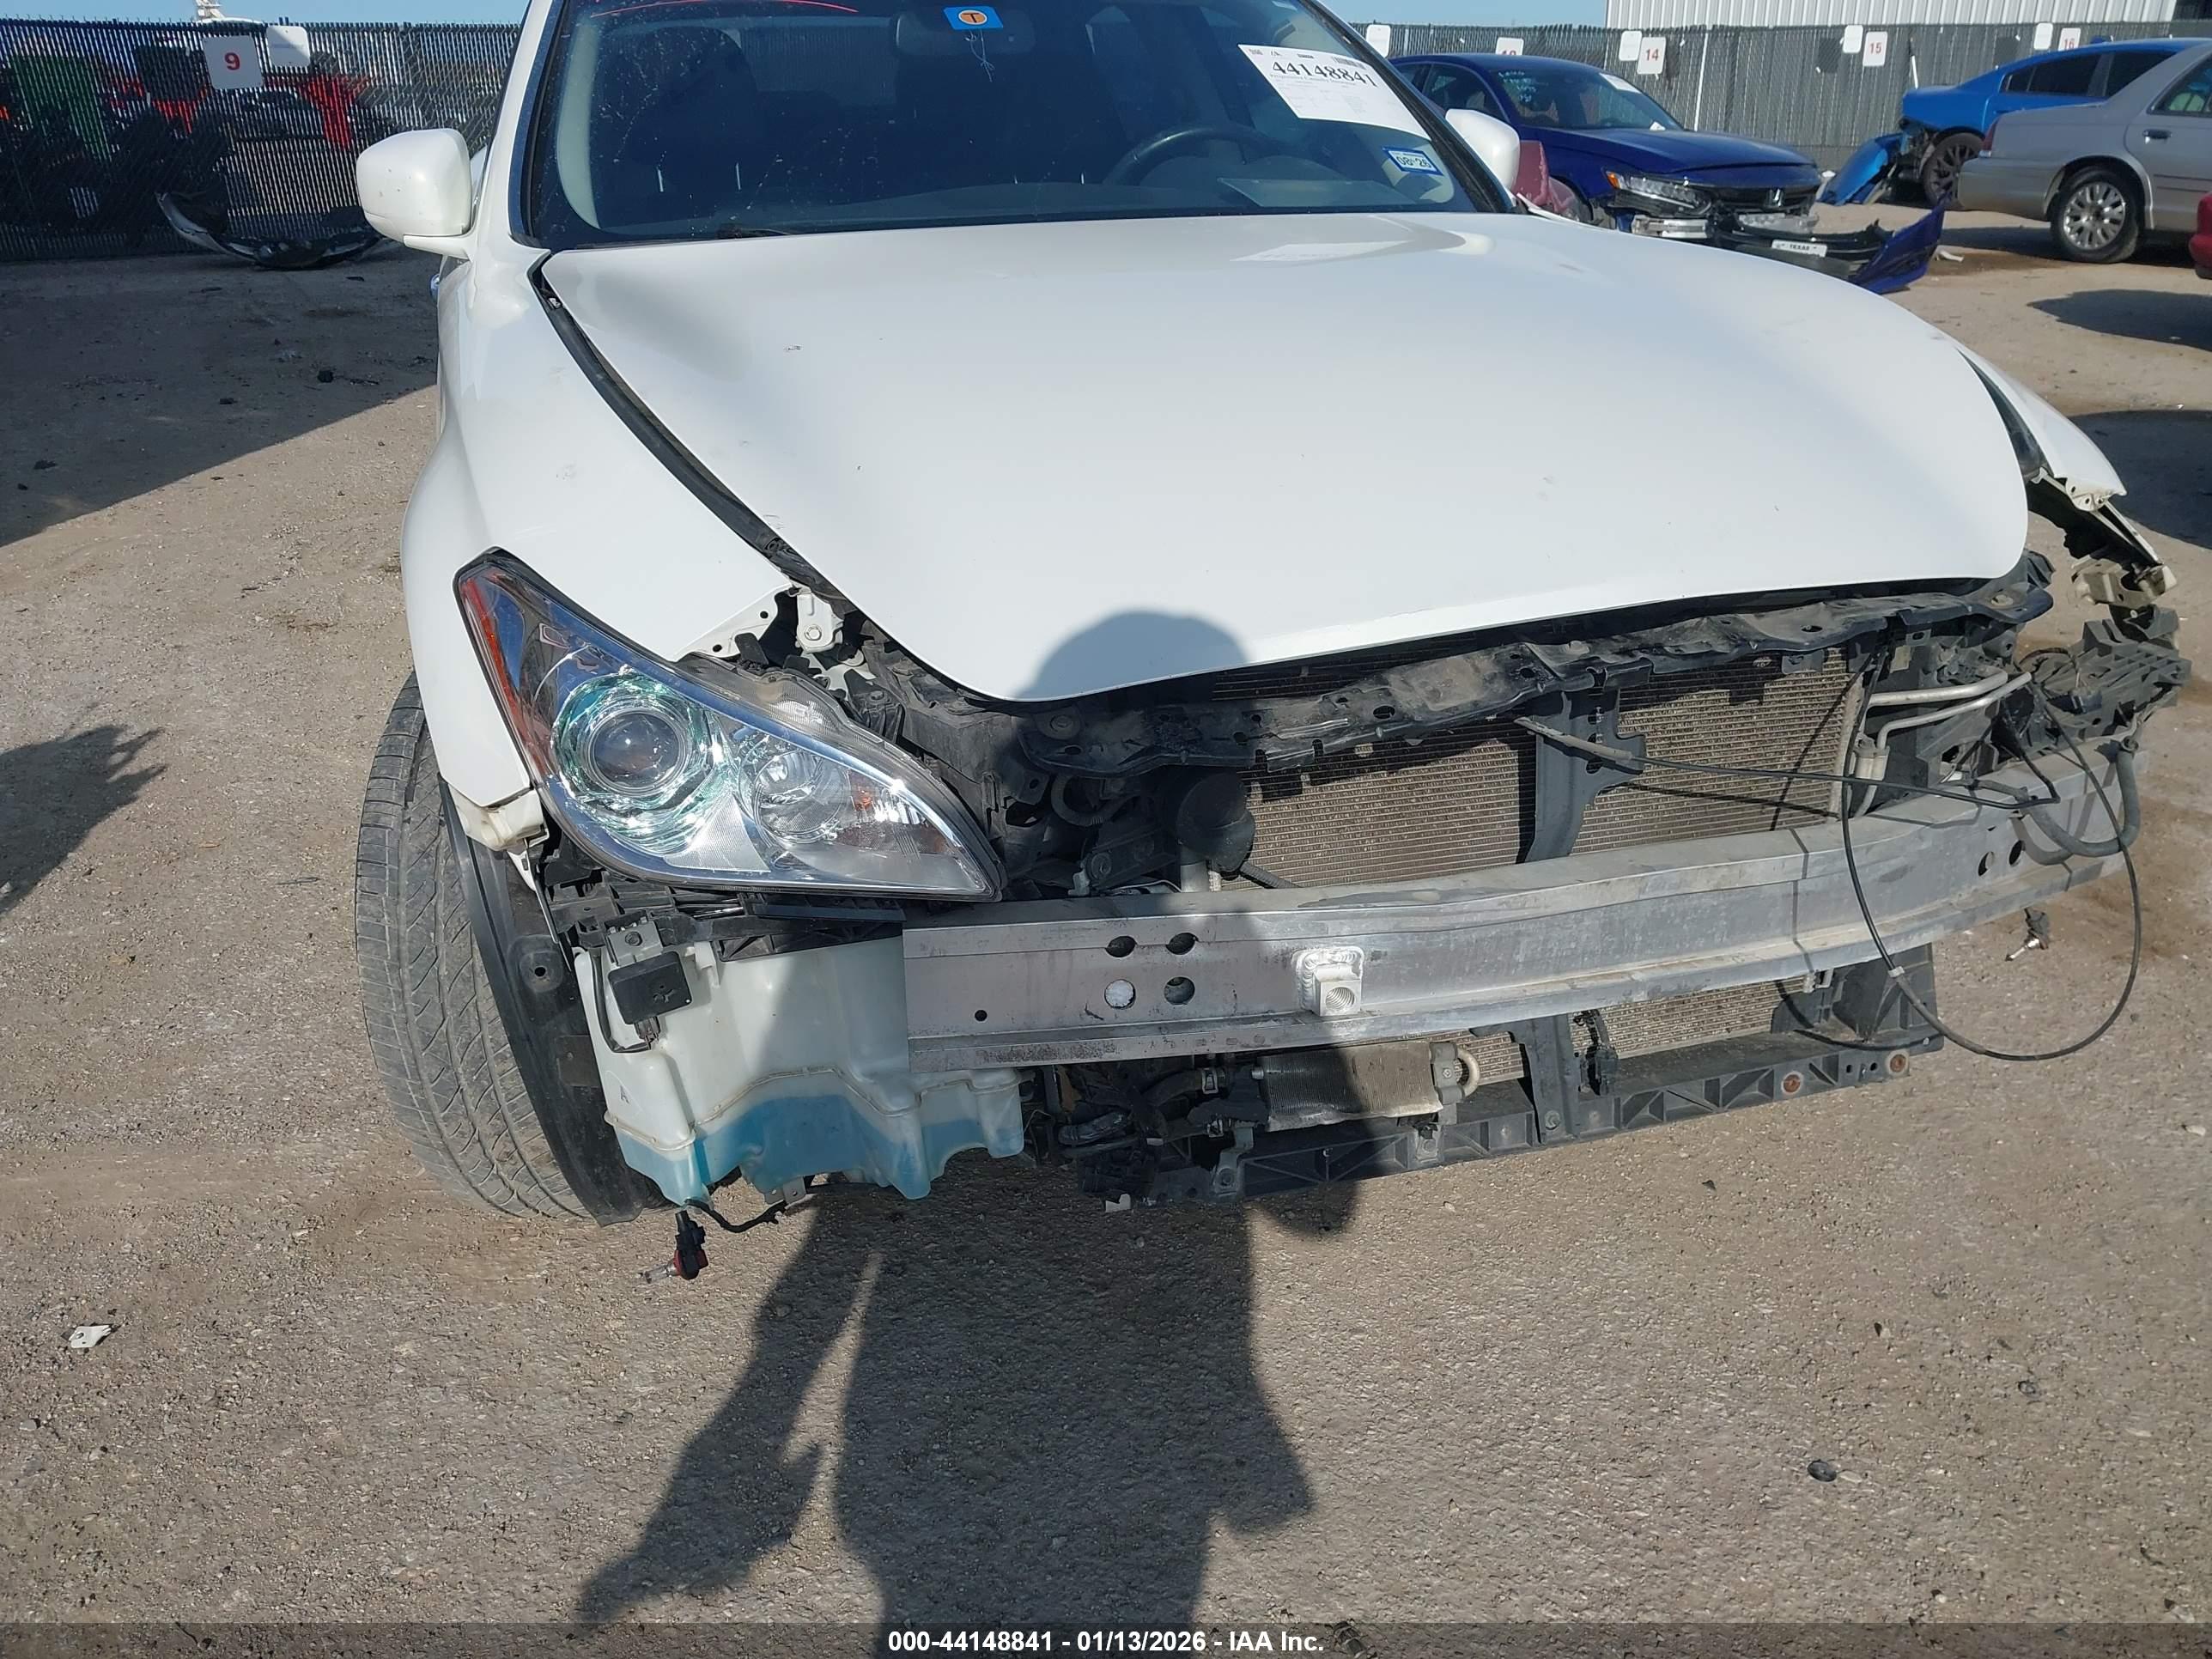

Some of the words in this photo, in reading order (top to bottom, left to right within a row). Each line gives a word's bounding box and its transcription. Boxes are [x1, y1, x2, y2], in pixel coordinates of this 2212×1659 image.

[1645, 48, 1659, 61] 14
[1869, 41, 1882, 54] 15
[224, 52, 240, 70] 9
[1273, 61, 1378, 88] 44148841
